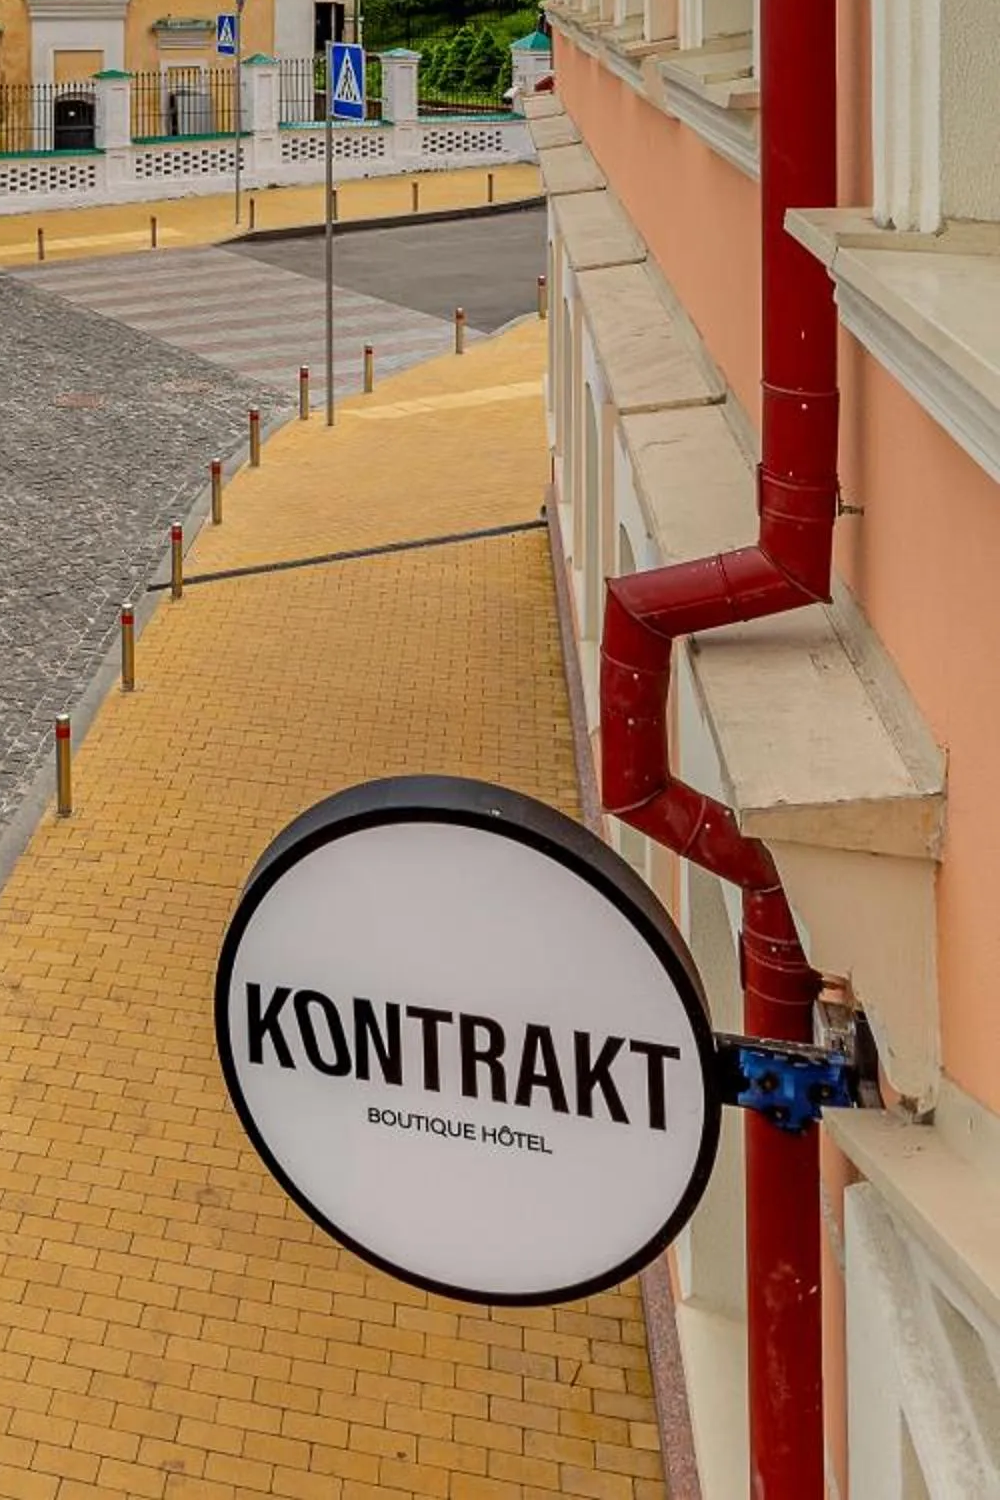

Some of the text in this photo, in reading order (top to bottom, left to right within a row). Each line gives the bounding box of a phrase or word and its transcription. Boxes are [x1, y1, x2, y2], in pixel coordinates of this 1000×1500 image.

[245, 981, 681, 1132] KONTRAKT
[367, 1107, 553, 1155] BOUTIQUE HÔTEL
